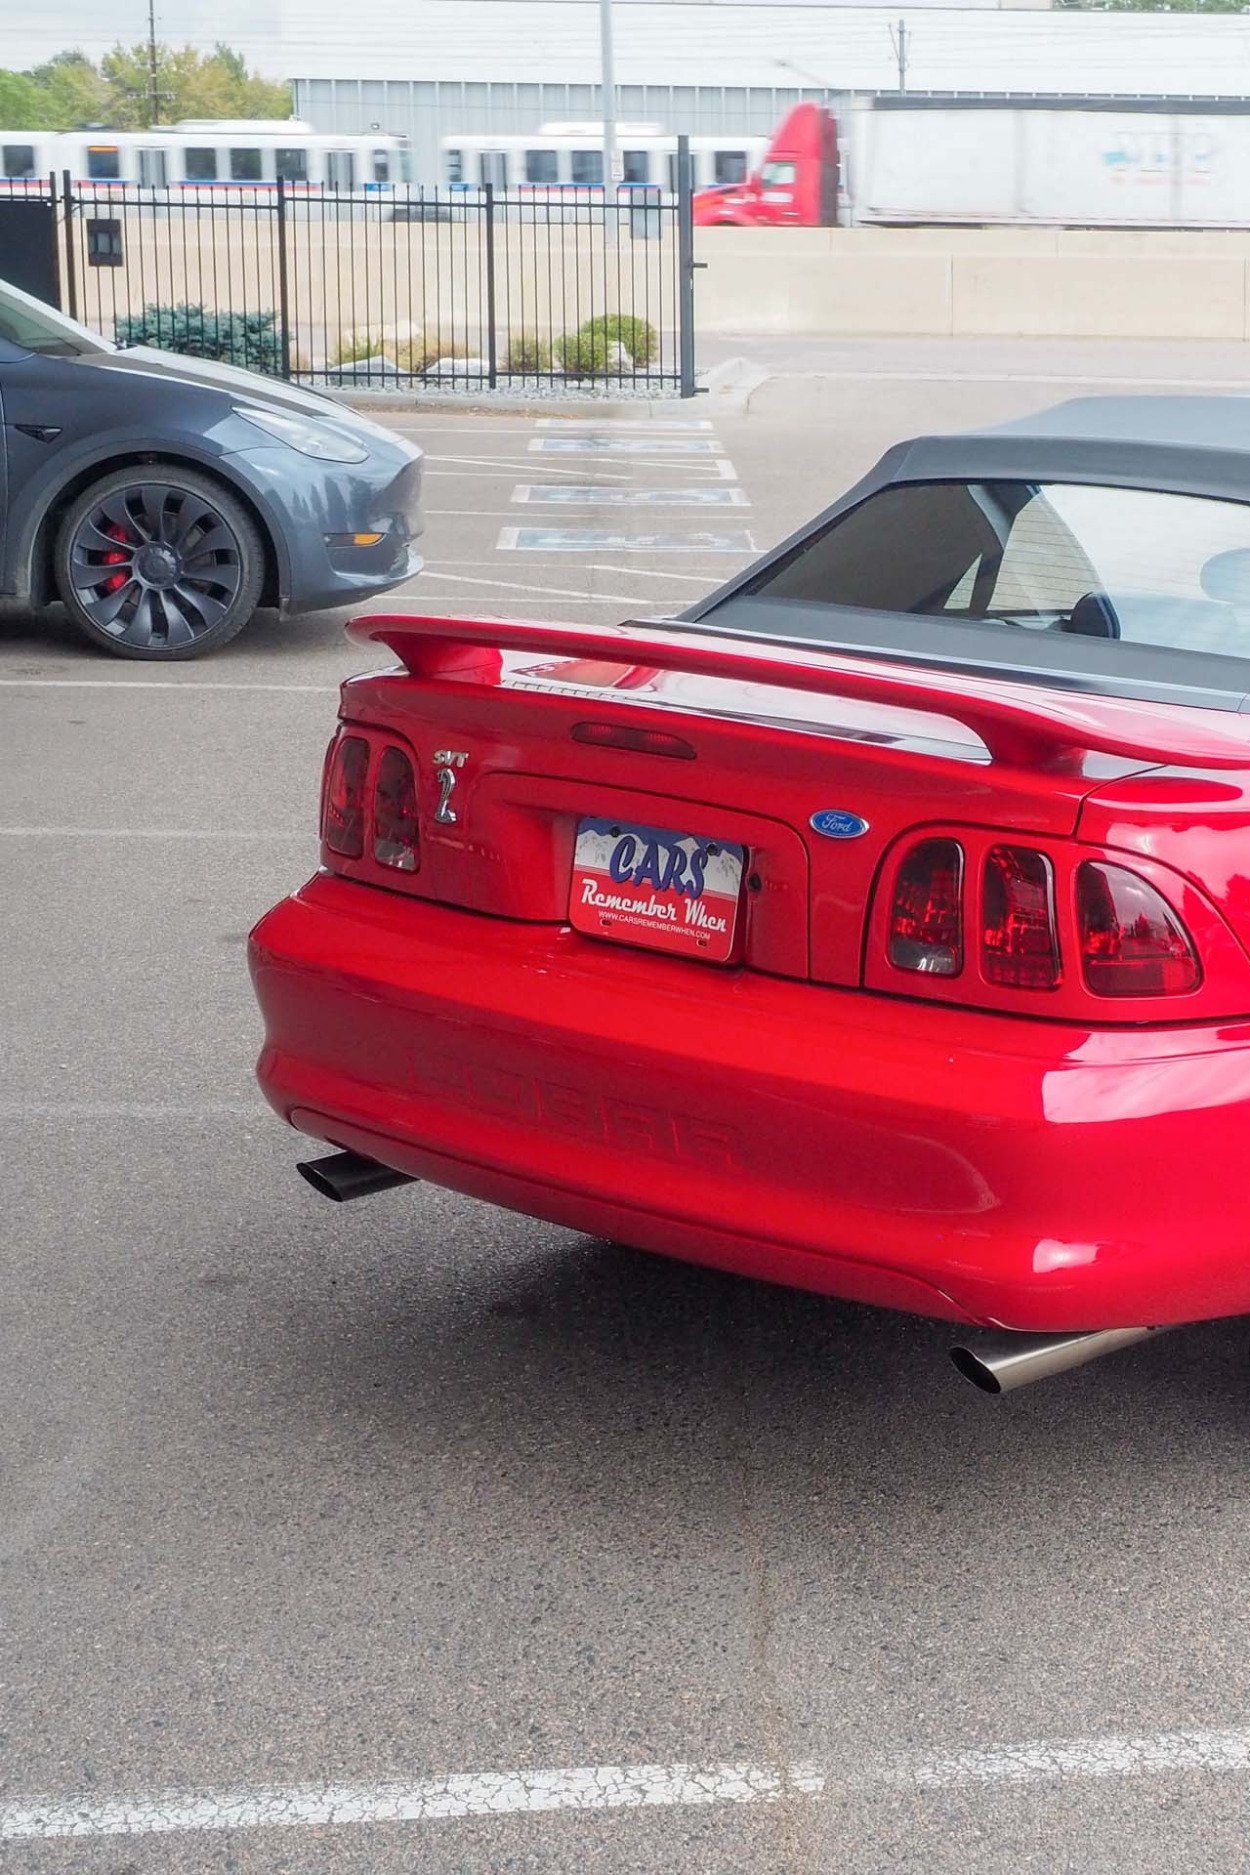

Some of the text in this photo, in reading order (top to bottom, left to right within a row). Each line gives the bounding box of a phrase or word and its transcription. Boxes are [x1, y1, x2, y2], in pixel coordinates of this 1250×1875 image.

[432, 749, 469, 768] SVT
[820, 813, 852, 832] Ford
[608, 834, 709, 898] CARS
[580, 879, 727, 933] Remember When
[598, 910, 711, 940] WWW.CARSREMEMBERWHEN.COM
